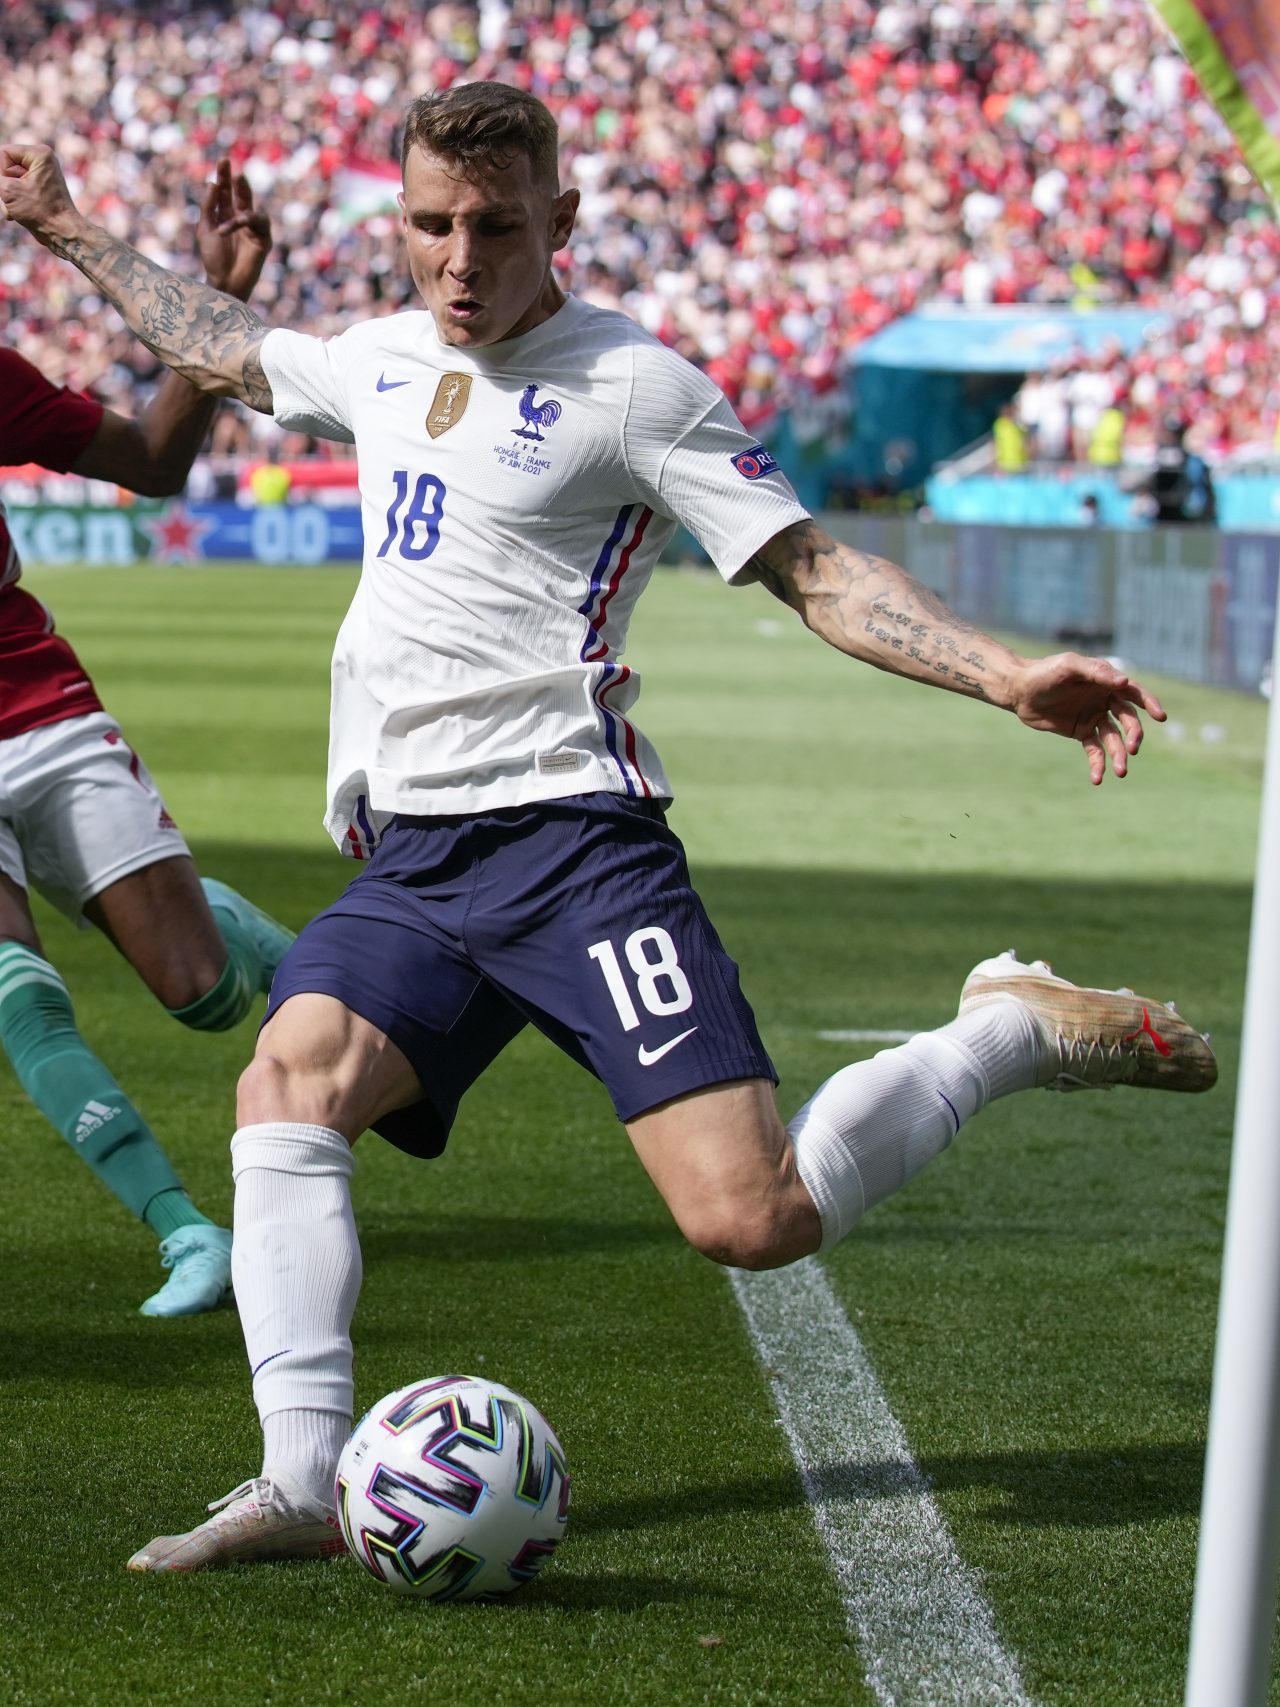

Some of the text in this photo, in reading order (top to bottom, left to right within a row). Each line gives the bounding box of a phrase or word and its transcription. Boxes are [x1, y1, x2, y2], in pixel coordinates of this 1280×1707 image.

[434, 415, 451, 424] FIFA
[522, 463, 541, 476] 2021
[526, 455, 551, 470] FRANCE
[376, 470, 447, 561] 18
[587, 926, 693, 1032] 18
[75, 1106, 122, 1142] adidas
